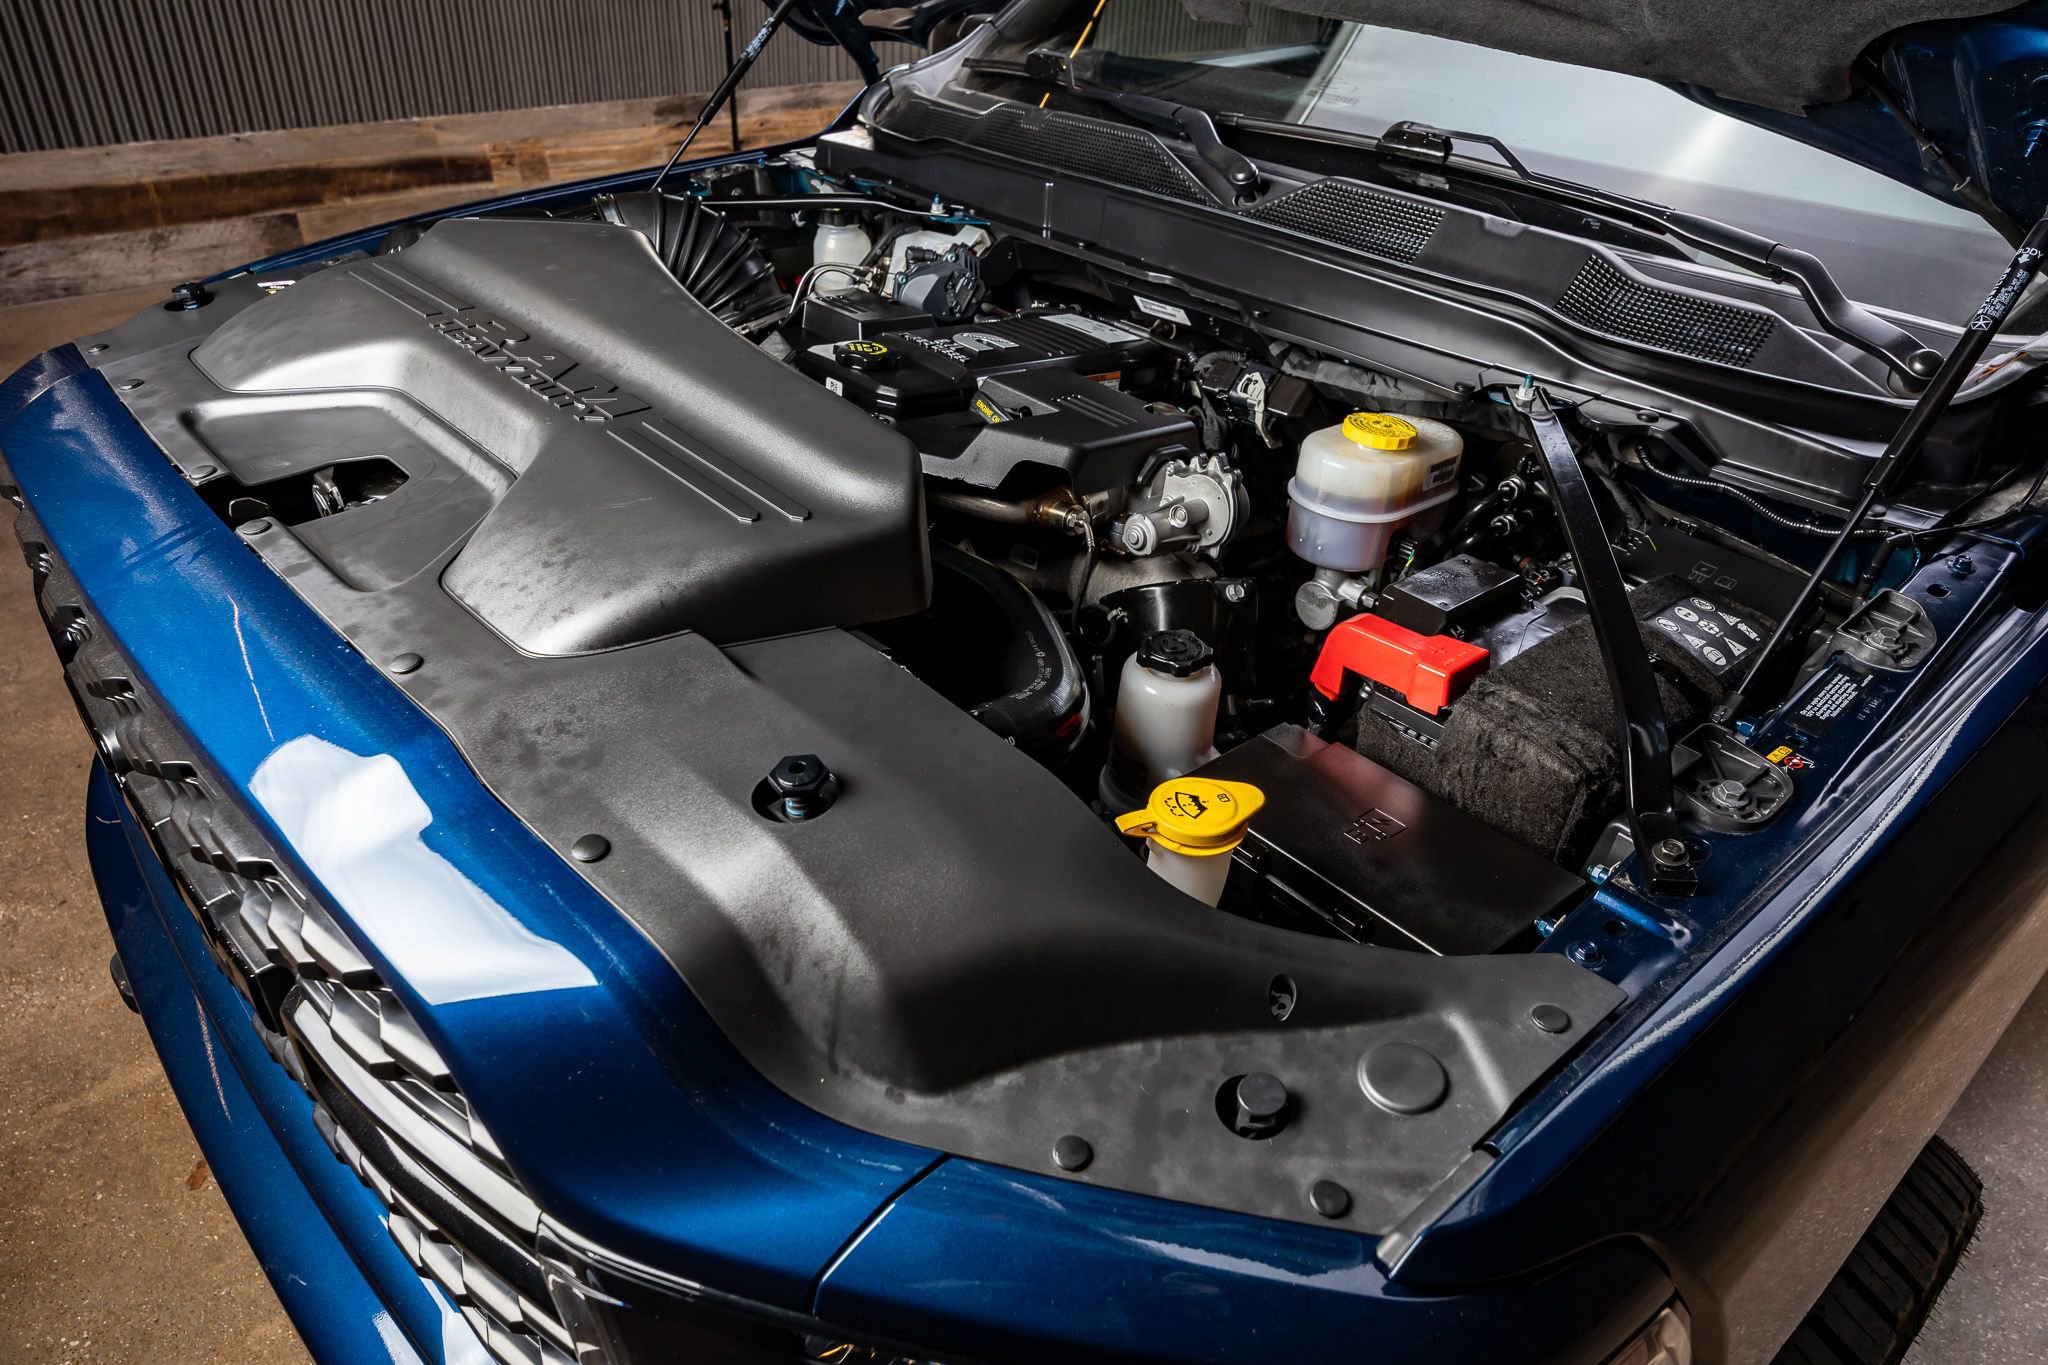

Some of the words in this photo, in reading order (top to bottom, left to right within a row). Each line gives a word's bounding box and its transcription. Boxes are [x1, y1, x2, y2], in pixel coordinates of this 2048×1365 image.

[2016, 247, 2044, 259] BODY
[428, 321, 525, 372] HEAVY
[510, 373, 607, 422] DUTY
[453, 314, 653, 420] RAM
[975, 399, 994, 418] ENGINE
